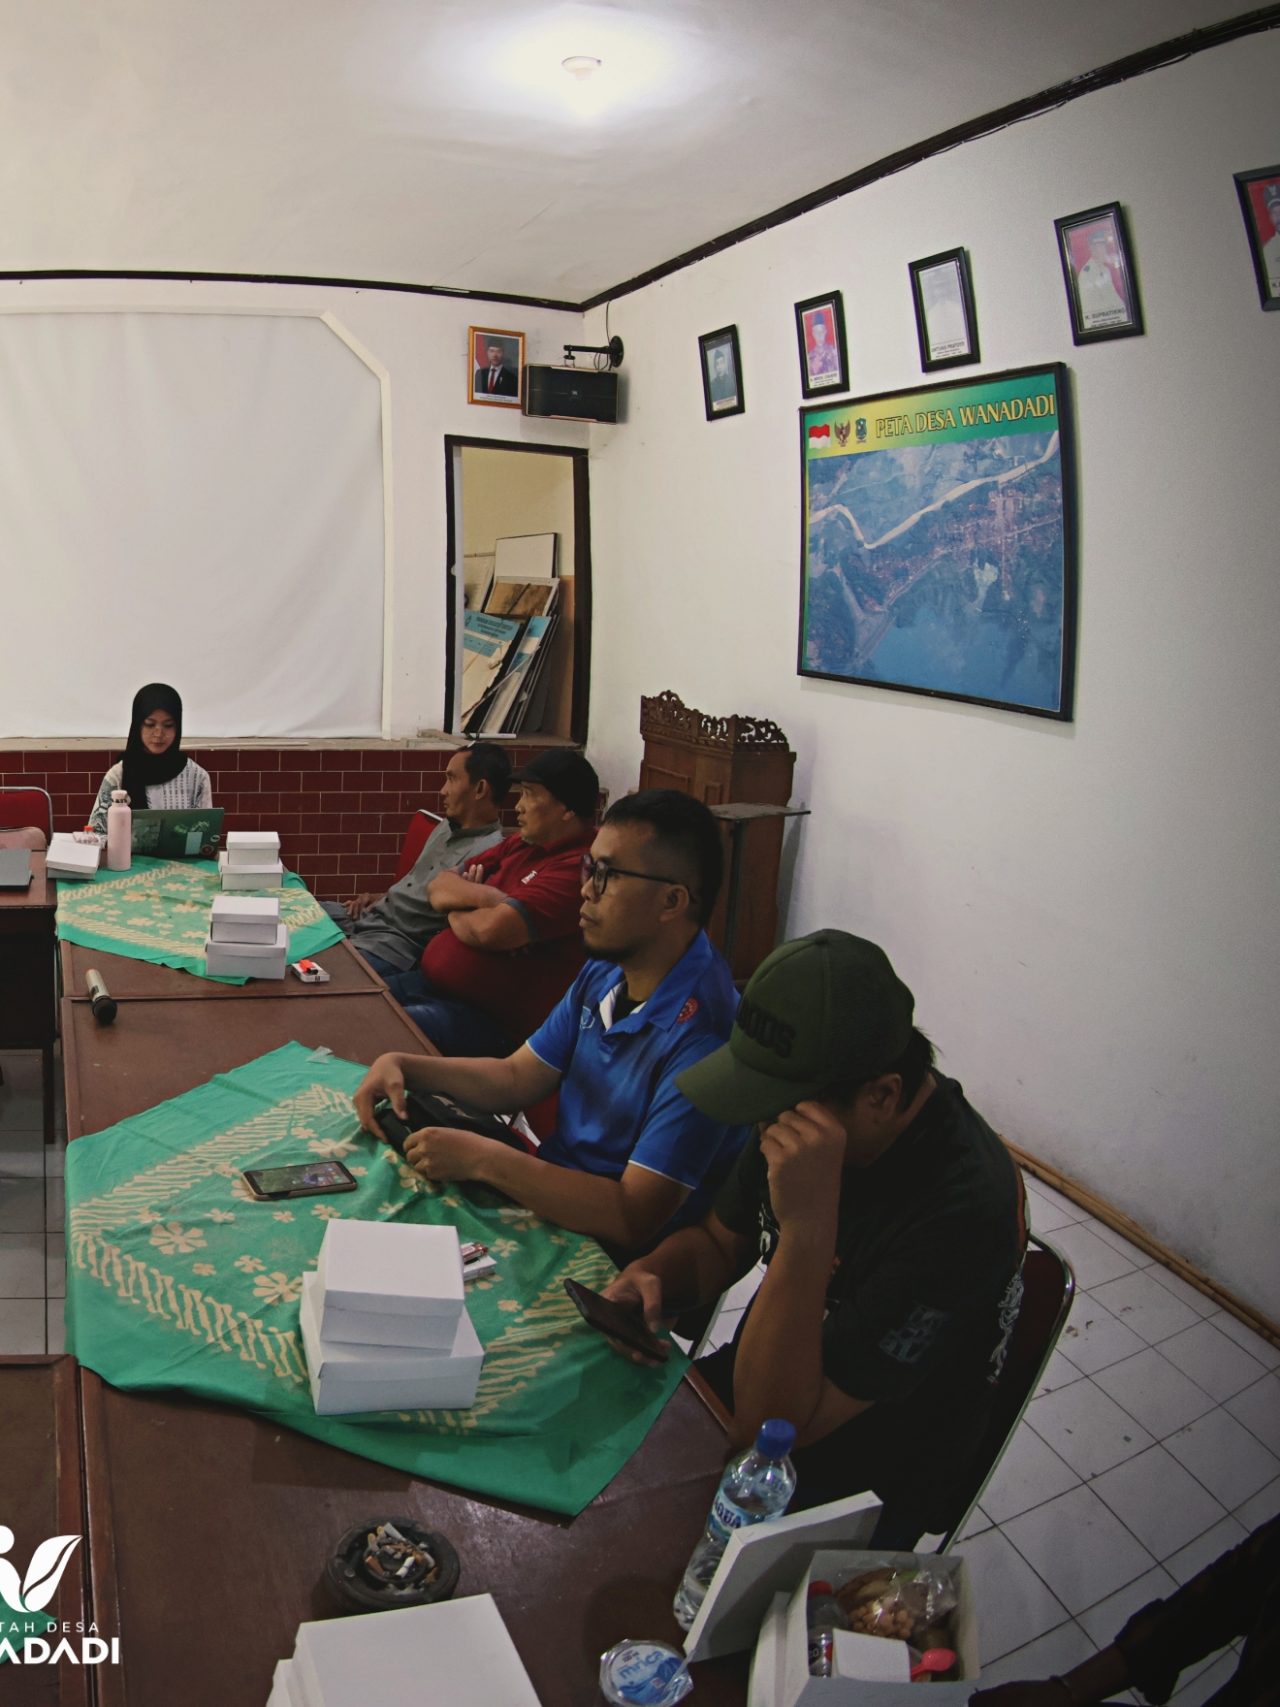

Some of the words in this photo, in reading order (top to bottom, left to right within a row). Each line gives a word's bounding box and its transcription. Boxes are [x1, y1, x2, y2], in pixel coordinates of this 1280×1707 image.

[875, 414, 914, 438] PETA
[915, 408, 956, 433] DESA
[959, 394, 1055, 426] WANADADI
